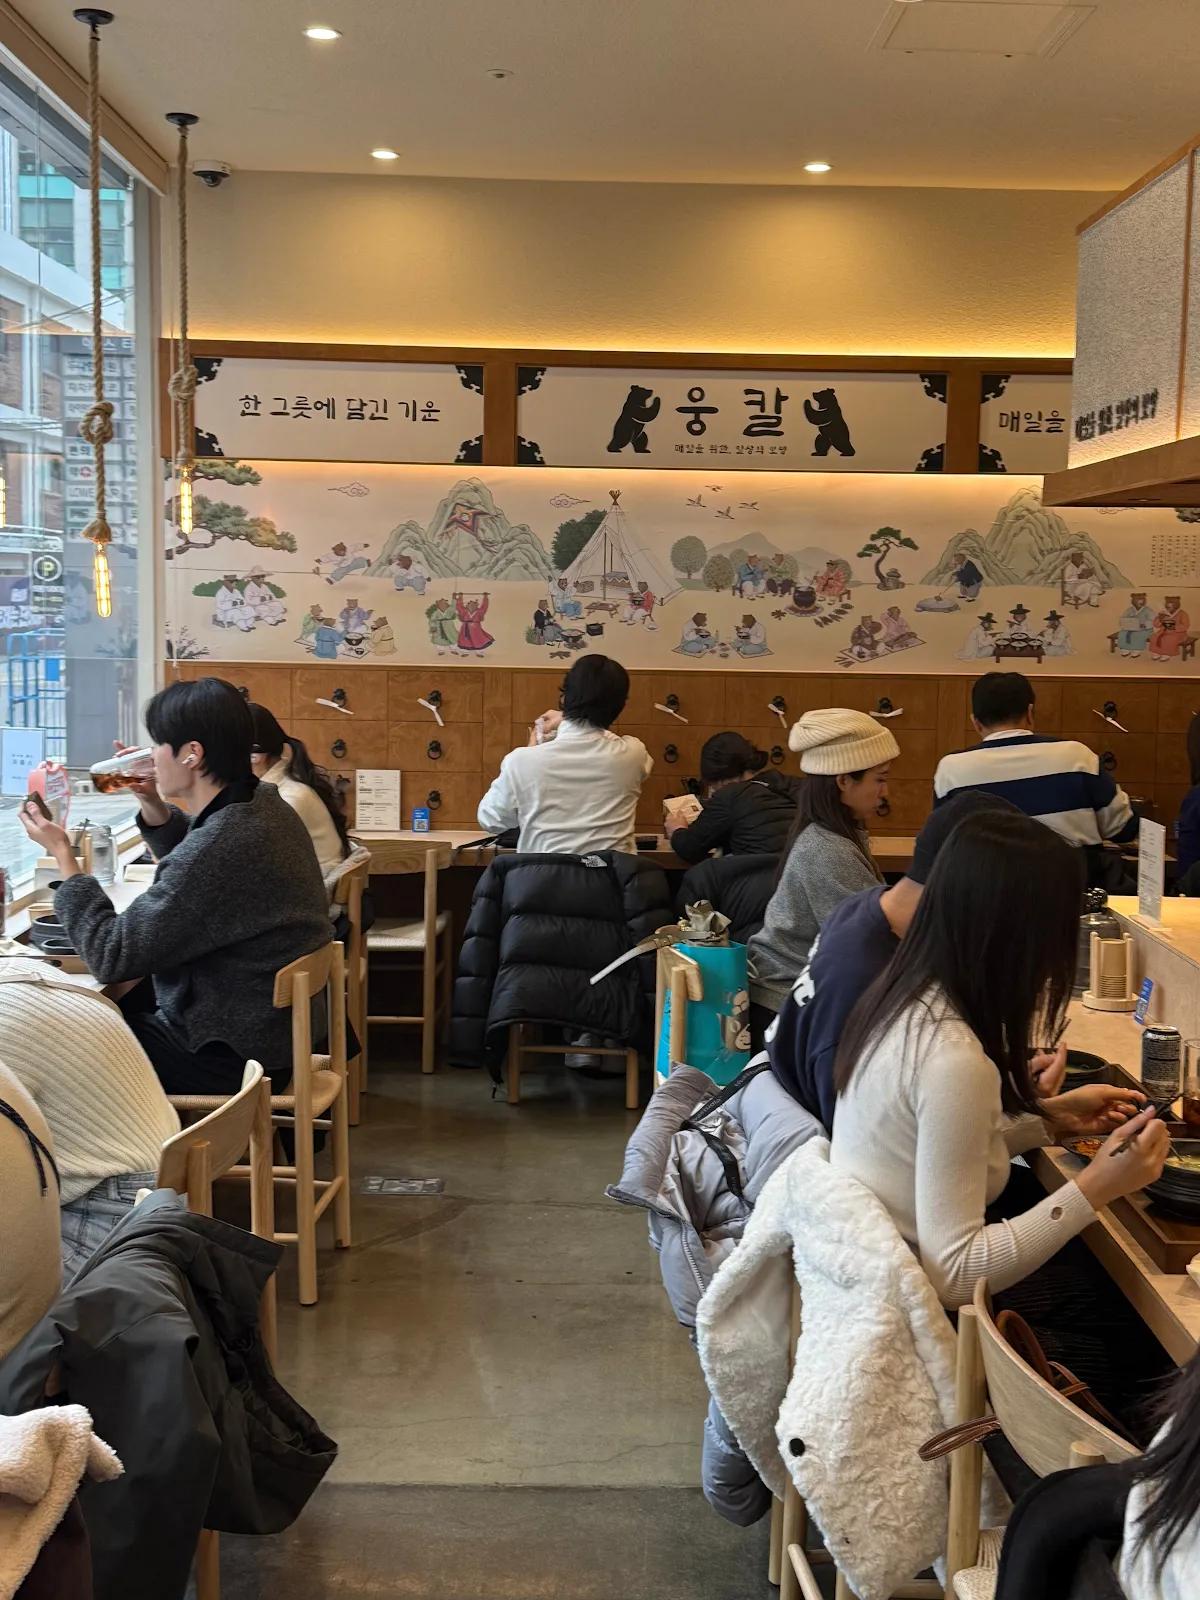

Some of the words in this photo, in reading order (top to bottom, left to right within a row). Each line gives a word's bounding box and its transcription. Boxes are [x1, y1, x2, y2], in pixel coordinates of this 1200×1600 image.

[239, 395, 261, 417] 한
[269, 396, 336, 420] 그릇에
[346, 398, 389, 420] 담긴
[398, 399, 441, 422] 기운
[999, 410, 1066, 433] 매일을
[41, 561, 55, 577] P
